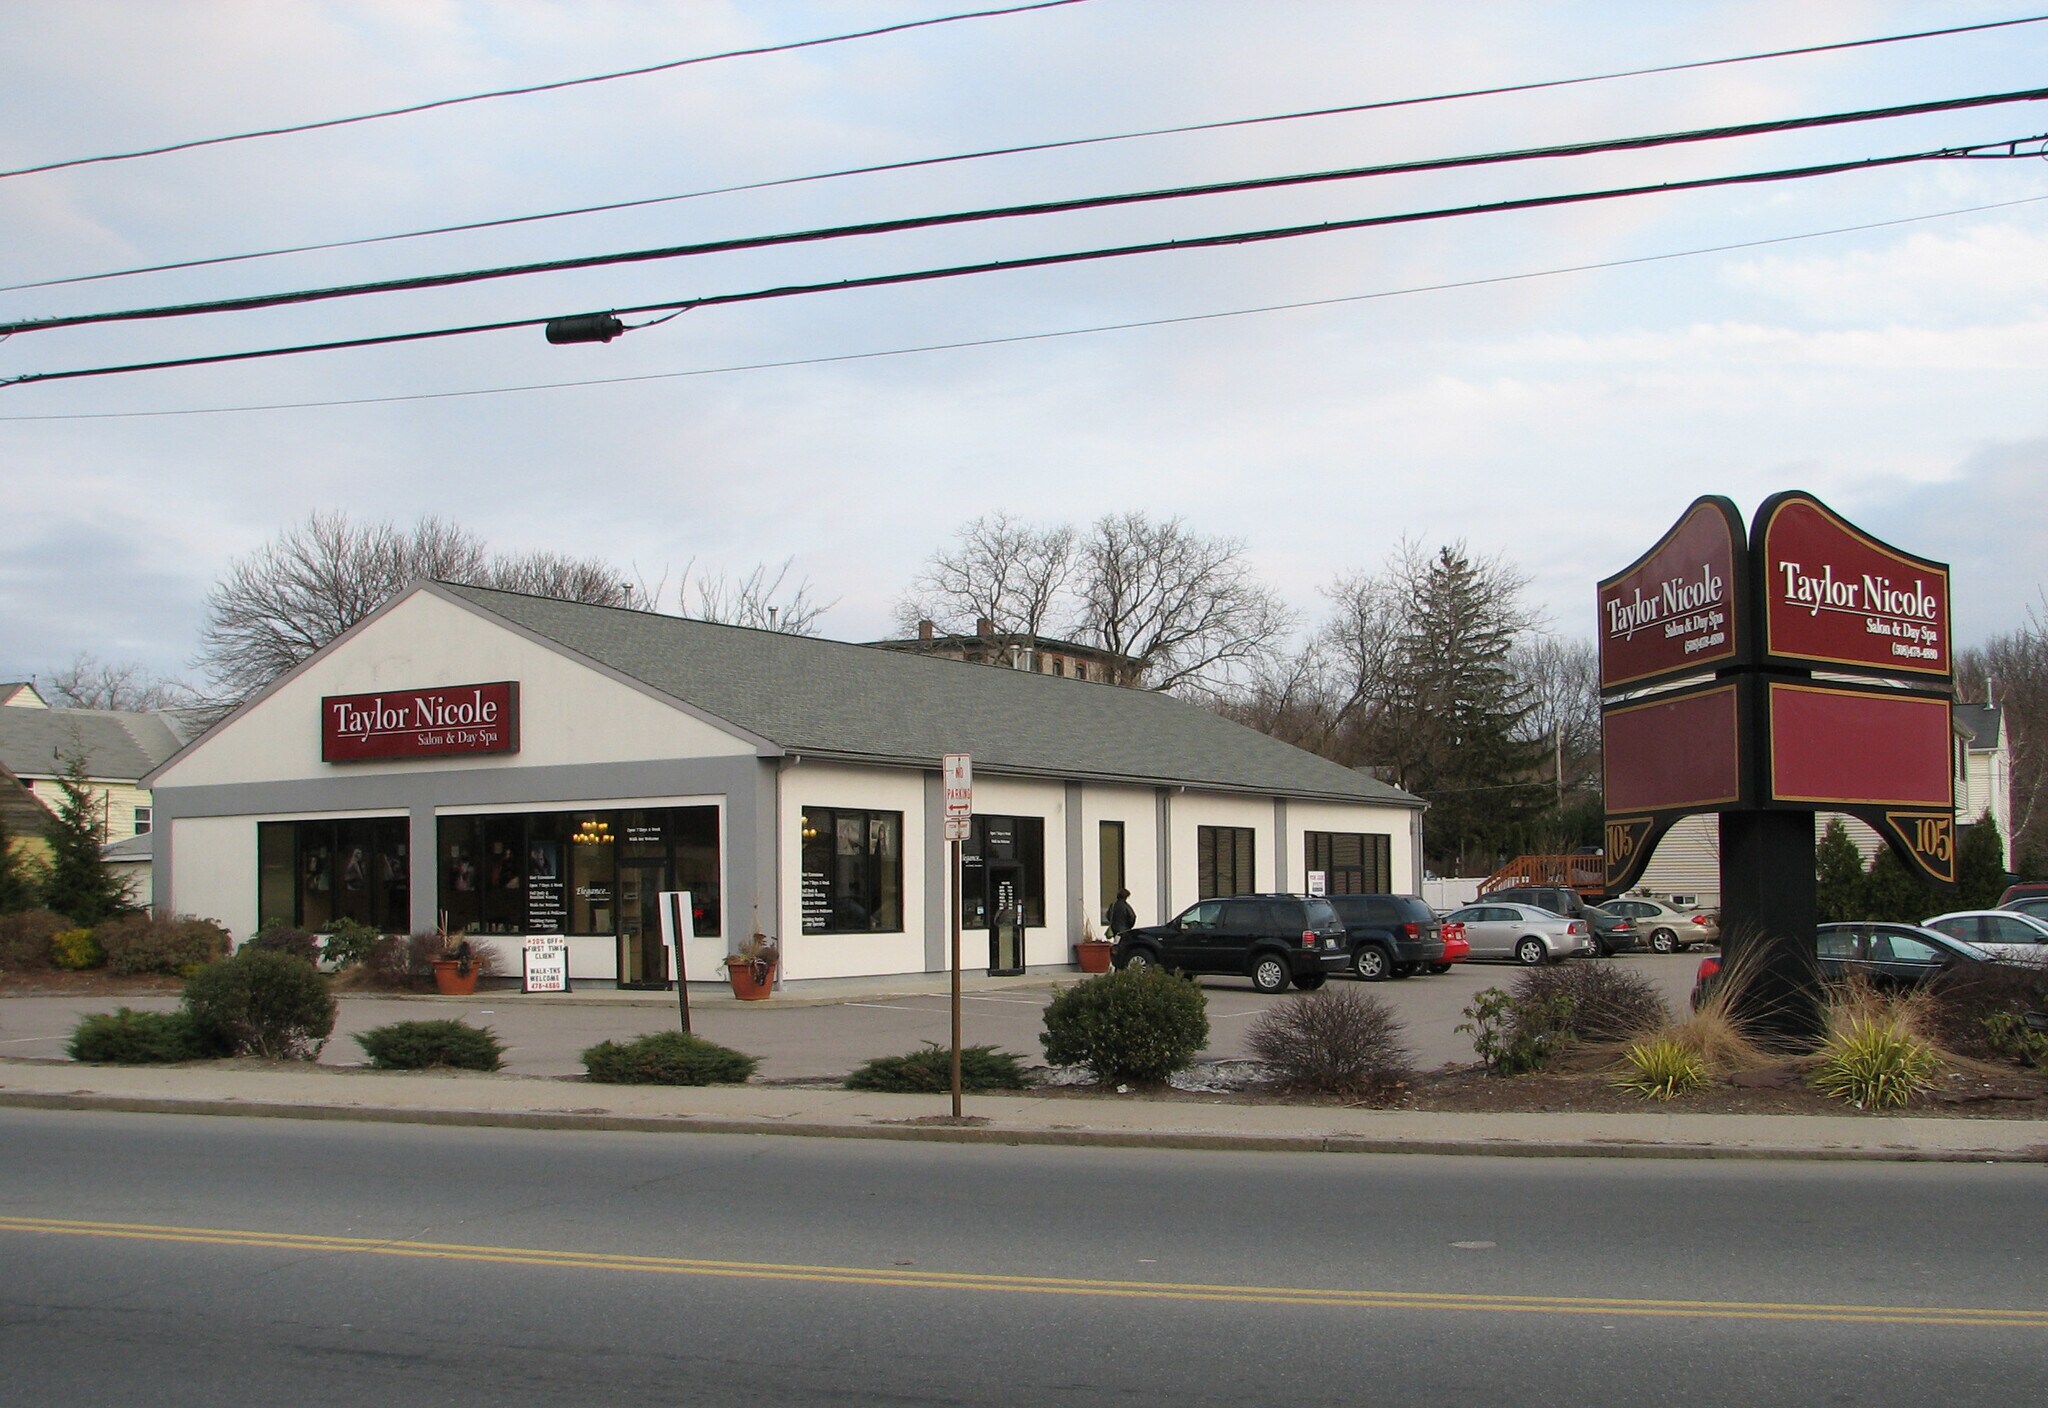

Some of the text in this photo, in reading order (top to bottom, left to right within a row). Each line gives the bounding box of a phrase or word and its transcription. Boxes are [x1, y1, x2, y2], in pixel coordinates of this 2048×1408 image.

[1606, 563, 1723, 642] Taylor Nicole
[1778, 561, 1937, 620] Taylor Nicole
[1664, 610, 1724, 639] Salon & Day Spa
[1866, 617, 1938, 646] Salon & Day Spa
[333, 690, 498, 743] Taylor Nicole
[418, 729, 498, 748] Salon & Day Spa
[955, 767, 964, 779] NO
[947, 788, 971, 800] PARKING
[1606, 824, 1634, 867] 105
[1914, 818, 1949, 862] 105
